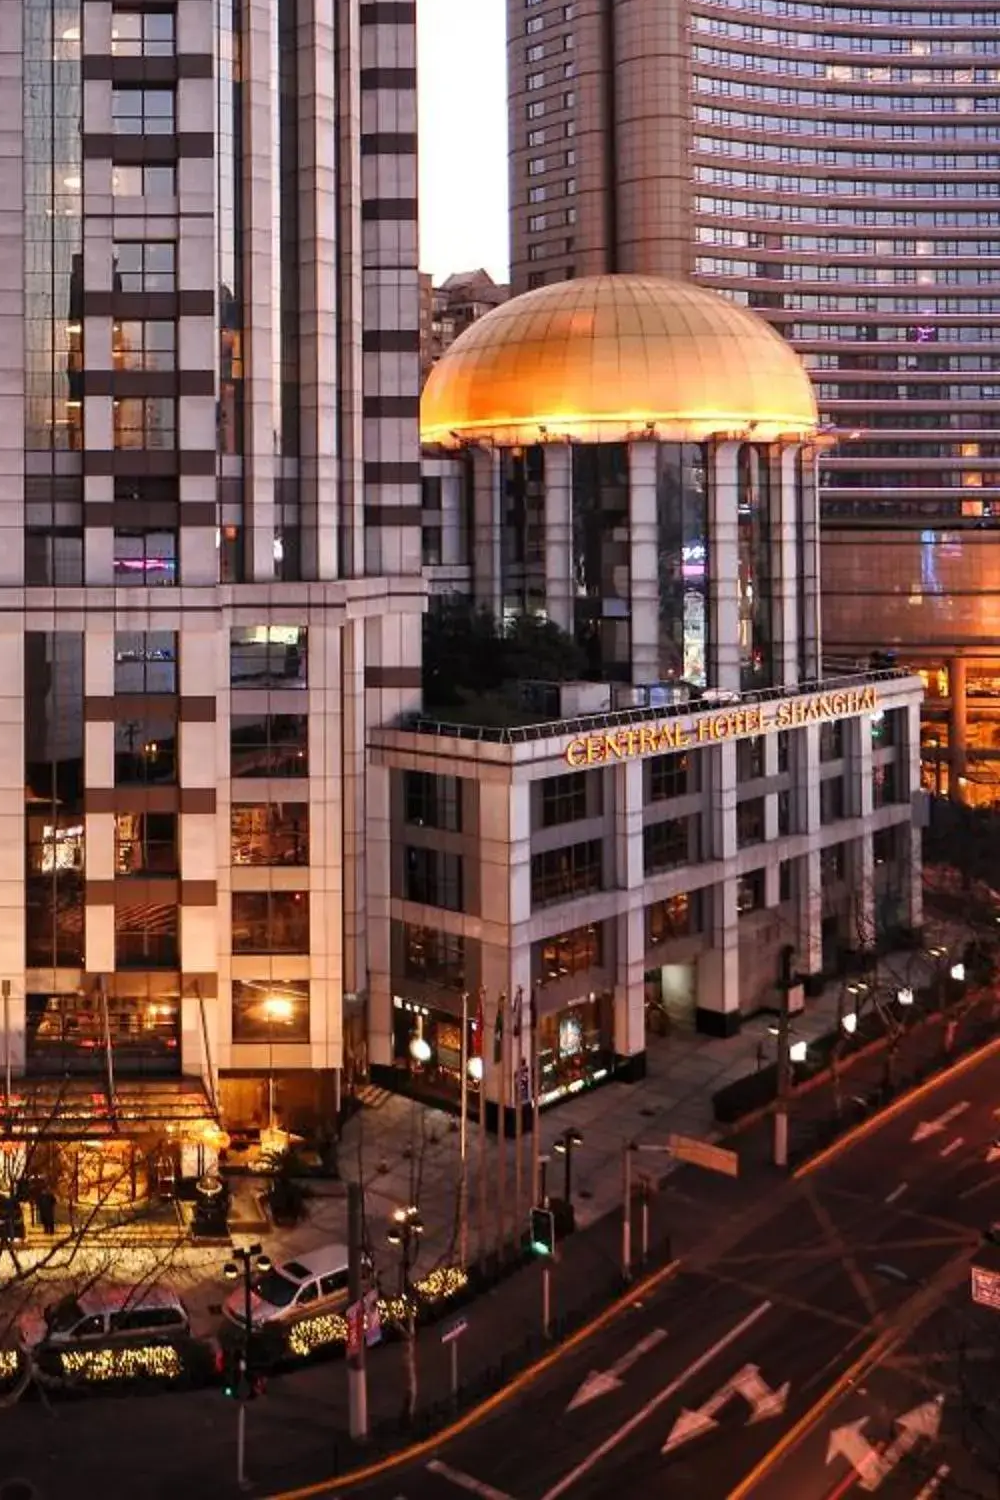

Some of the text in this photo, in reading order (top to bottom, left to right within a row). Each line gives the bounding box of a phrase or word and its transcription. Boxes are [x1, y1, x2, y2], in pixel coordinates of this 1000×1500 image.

[566, 687, 881, 767] CENTRAL HOTEL SHANGHAI
